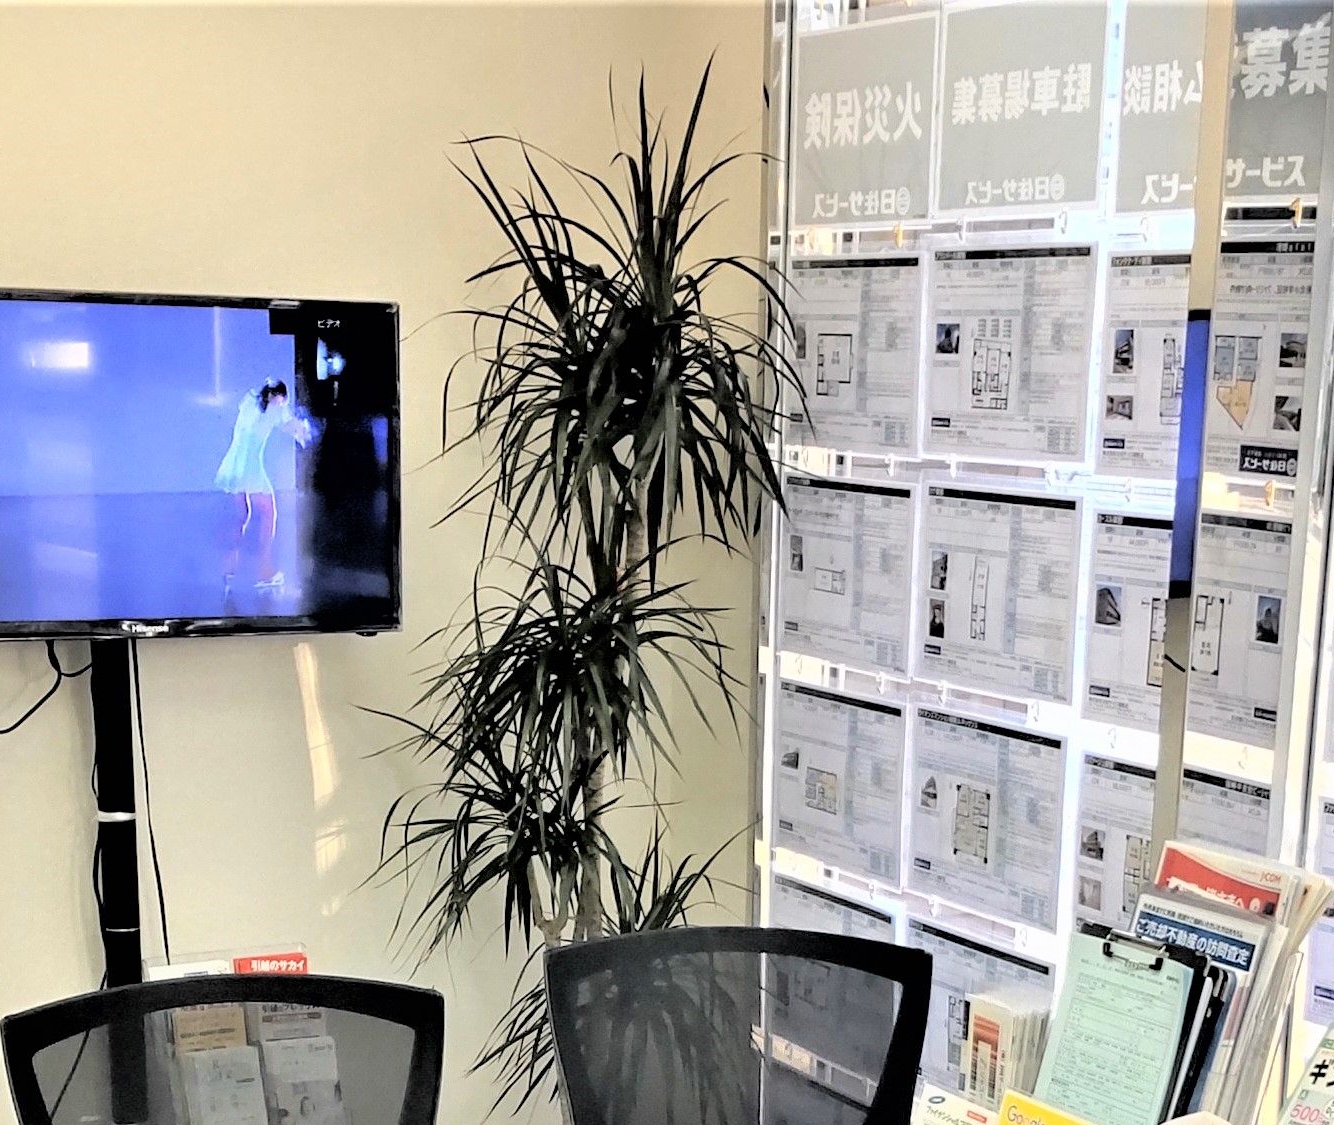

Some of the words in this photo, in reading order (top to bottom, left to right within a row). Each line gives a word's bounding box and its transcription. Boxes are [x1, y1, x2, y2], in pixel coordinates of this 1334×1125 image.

[1231, 12, 1331, 99] 募集
[1136, 917, 1251, 966] ご売却不動産の訪問査定
